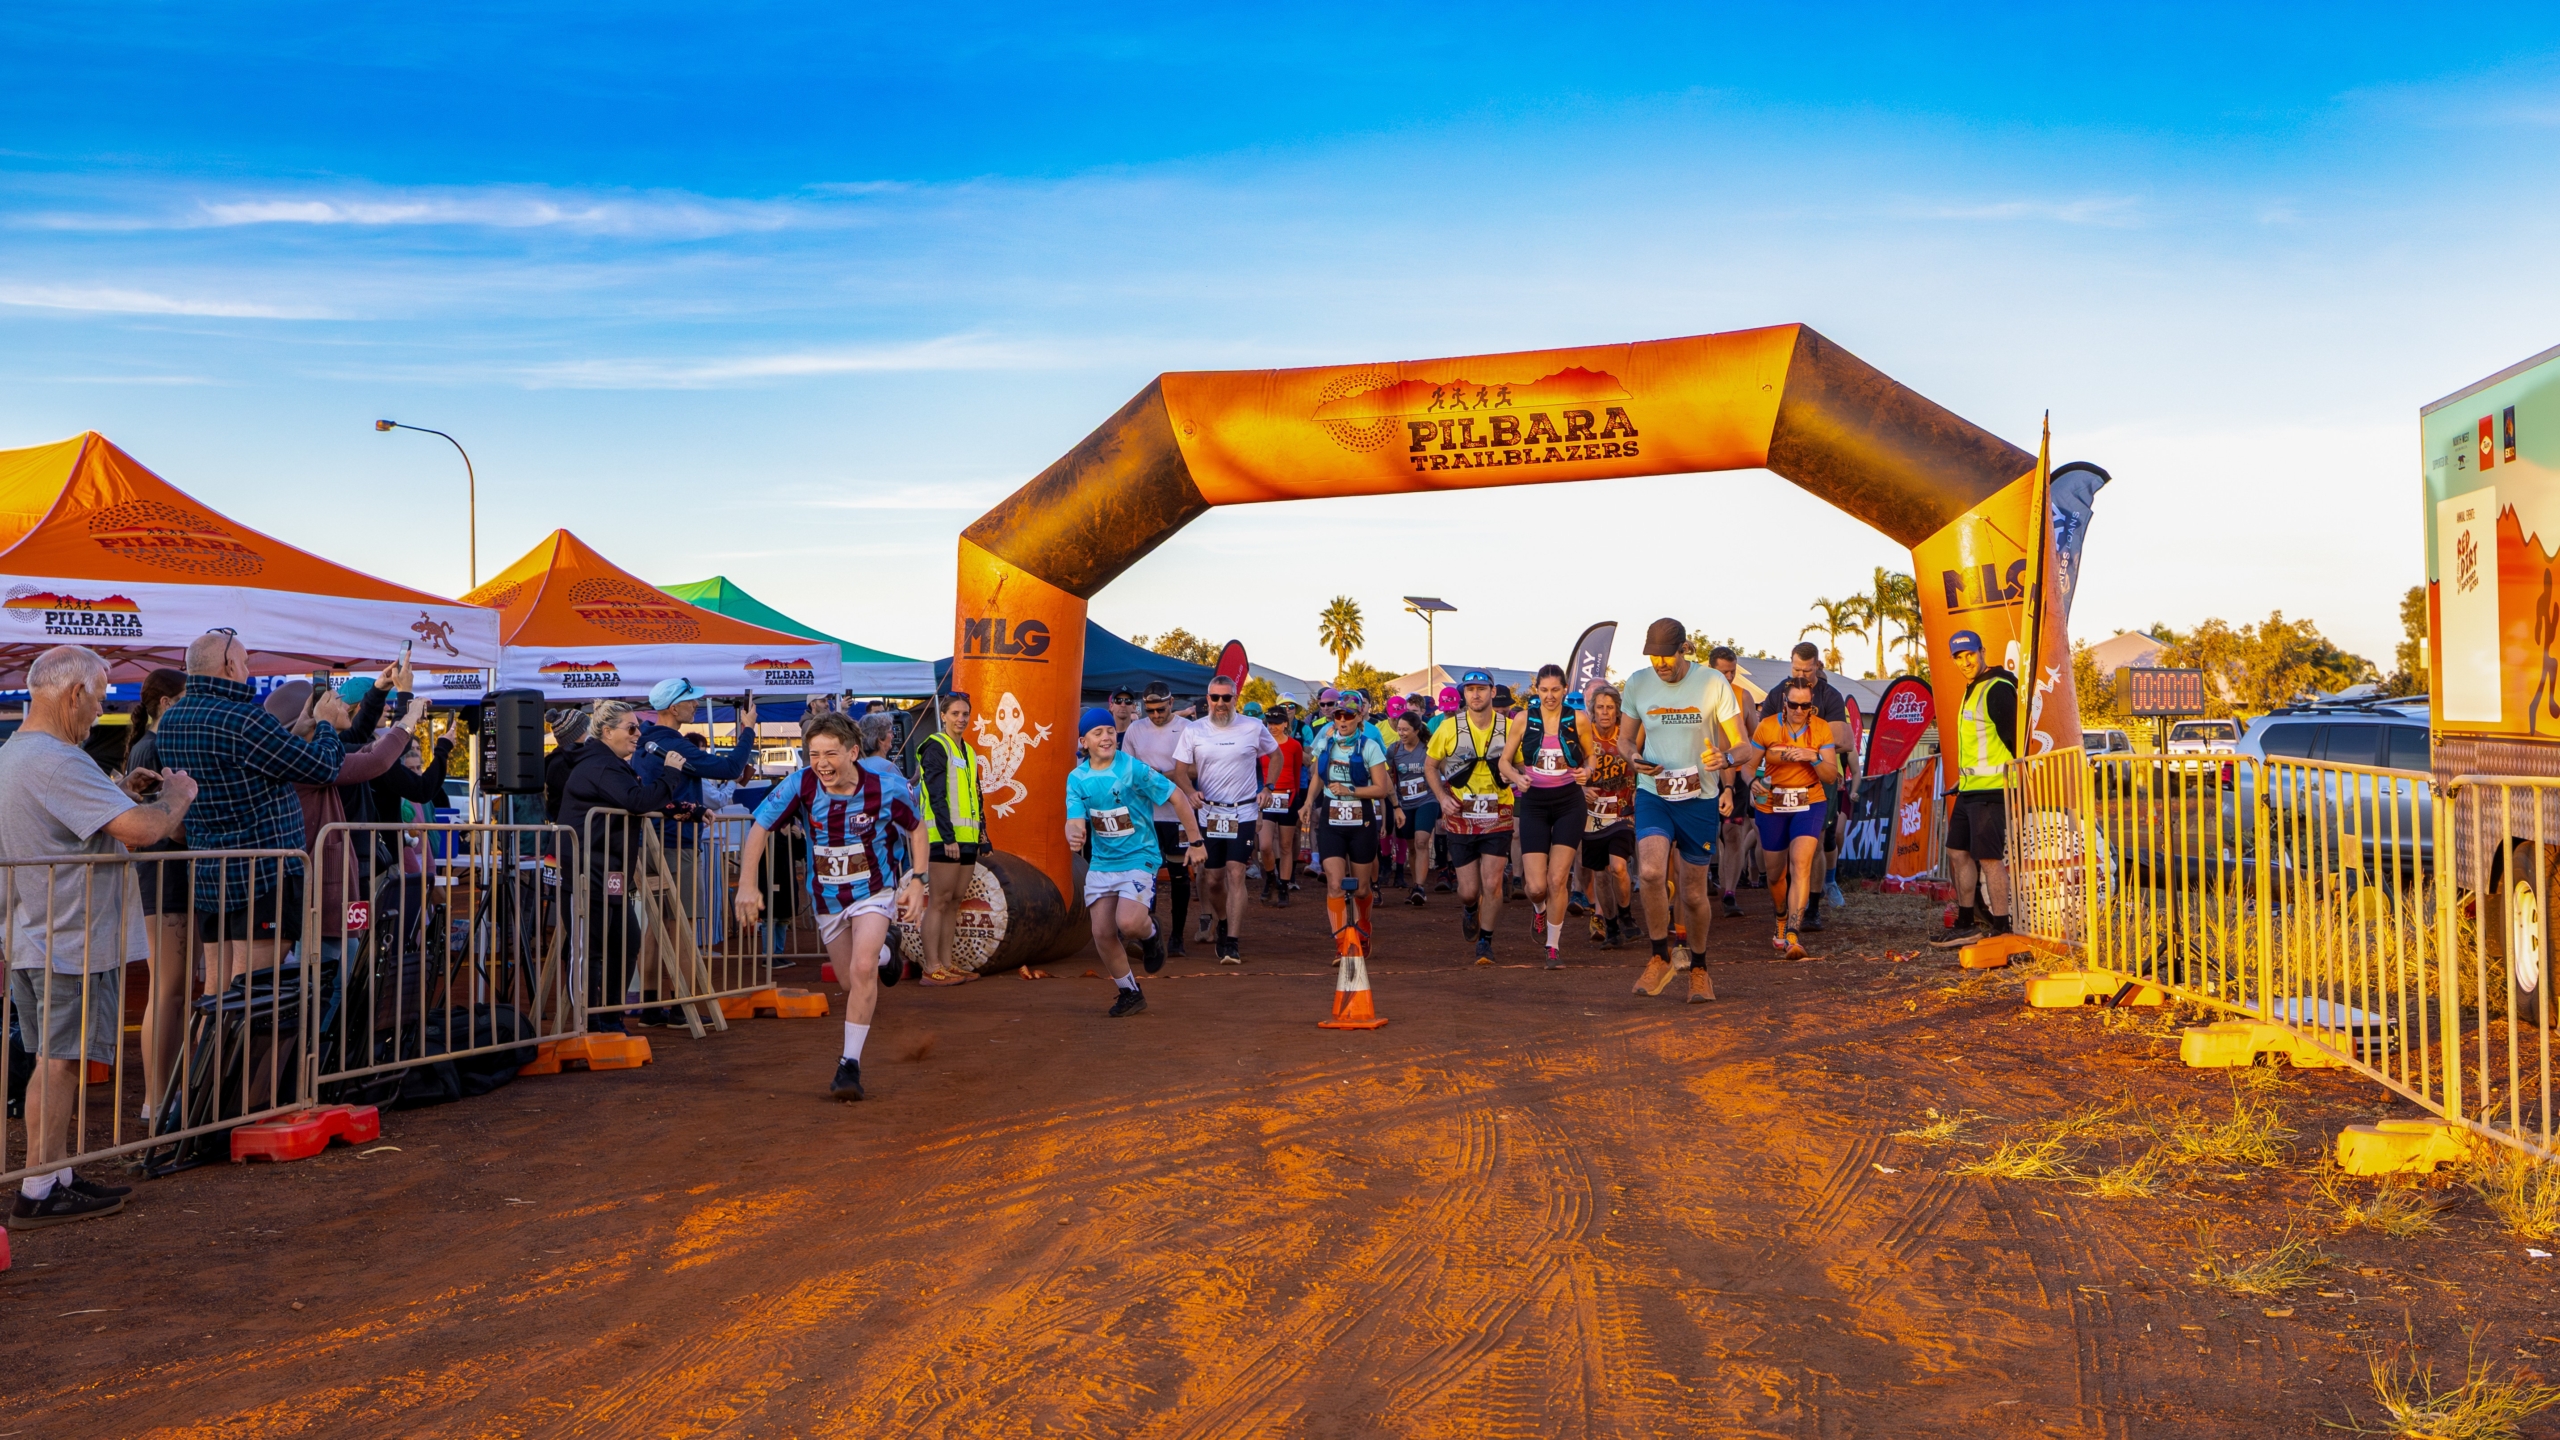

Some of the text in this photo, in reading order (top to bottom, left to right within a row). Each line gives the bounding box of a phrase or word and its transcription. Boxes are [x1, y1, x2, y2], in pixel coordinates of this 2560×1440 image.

[1407, 406, 1639, 453] PILBARA
[1410, 440, 1640, 471] TRAILBLAZERS
[2066, 510, 2080, 549] LOANS
[95, 537, 258, 555] PILBARA
[2457, 529, 2470, 560] RED
[2461, 541, 2478, 581] DIRT
[45, 611, 142, 628] PILBARA
[575, 609, 693, 619] PILBARA
[45, 626, 143, 637] TRAILBLAZERS
[963, 618, 1050, 656] MLG
[443, 675, 480, 684] PILBARA
[563, 673, 621, 682] PILBARA
[765, 671, 814, 680] PILBARA
[1894, 692, 1915, 703] RED
[1896, 702, 1926, 714] DIRT
[1542, 757, 1556, 770] 16
[1592, 761, 1627, 782] DIRT
[1407, 783, 1418, 795] 47
[1668, 777, 1689, 795] 22
[1472, 800, 1488, 813] 42
[1782, 793, 1799, 807] 45
[1338, 807, 1353, 820] 36
[1594, 802, 1608, 814] 77
[1102, 817, 1119, 832] 10
[1216, 820, 1230, 833] 48
[828, 856, 849, 876] 37
[607, 878, 621, 889] GCS
[347, 908, 367, 924] GCS
